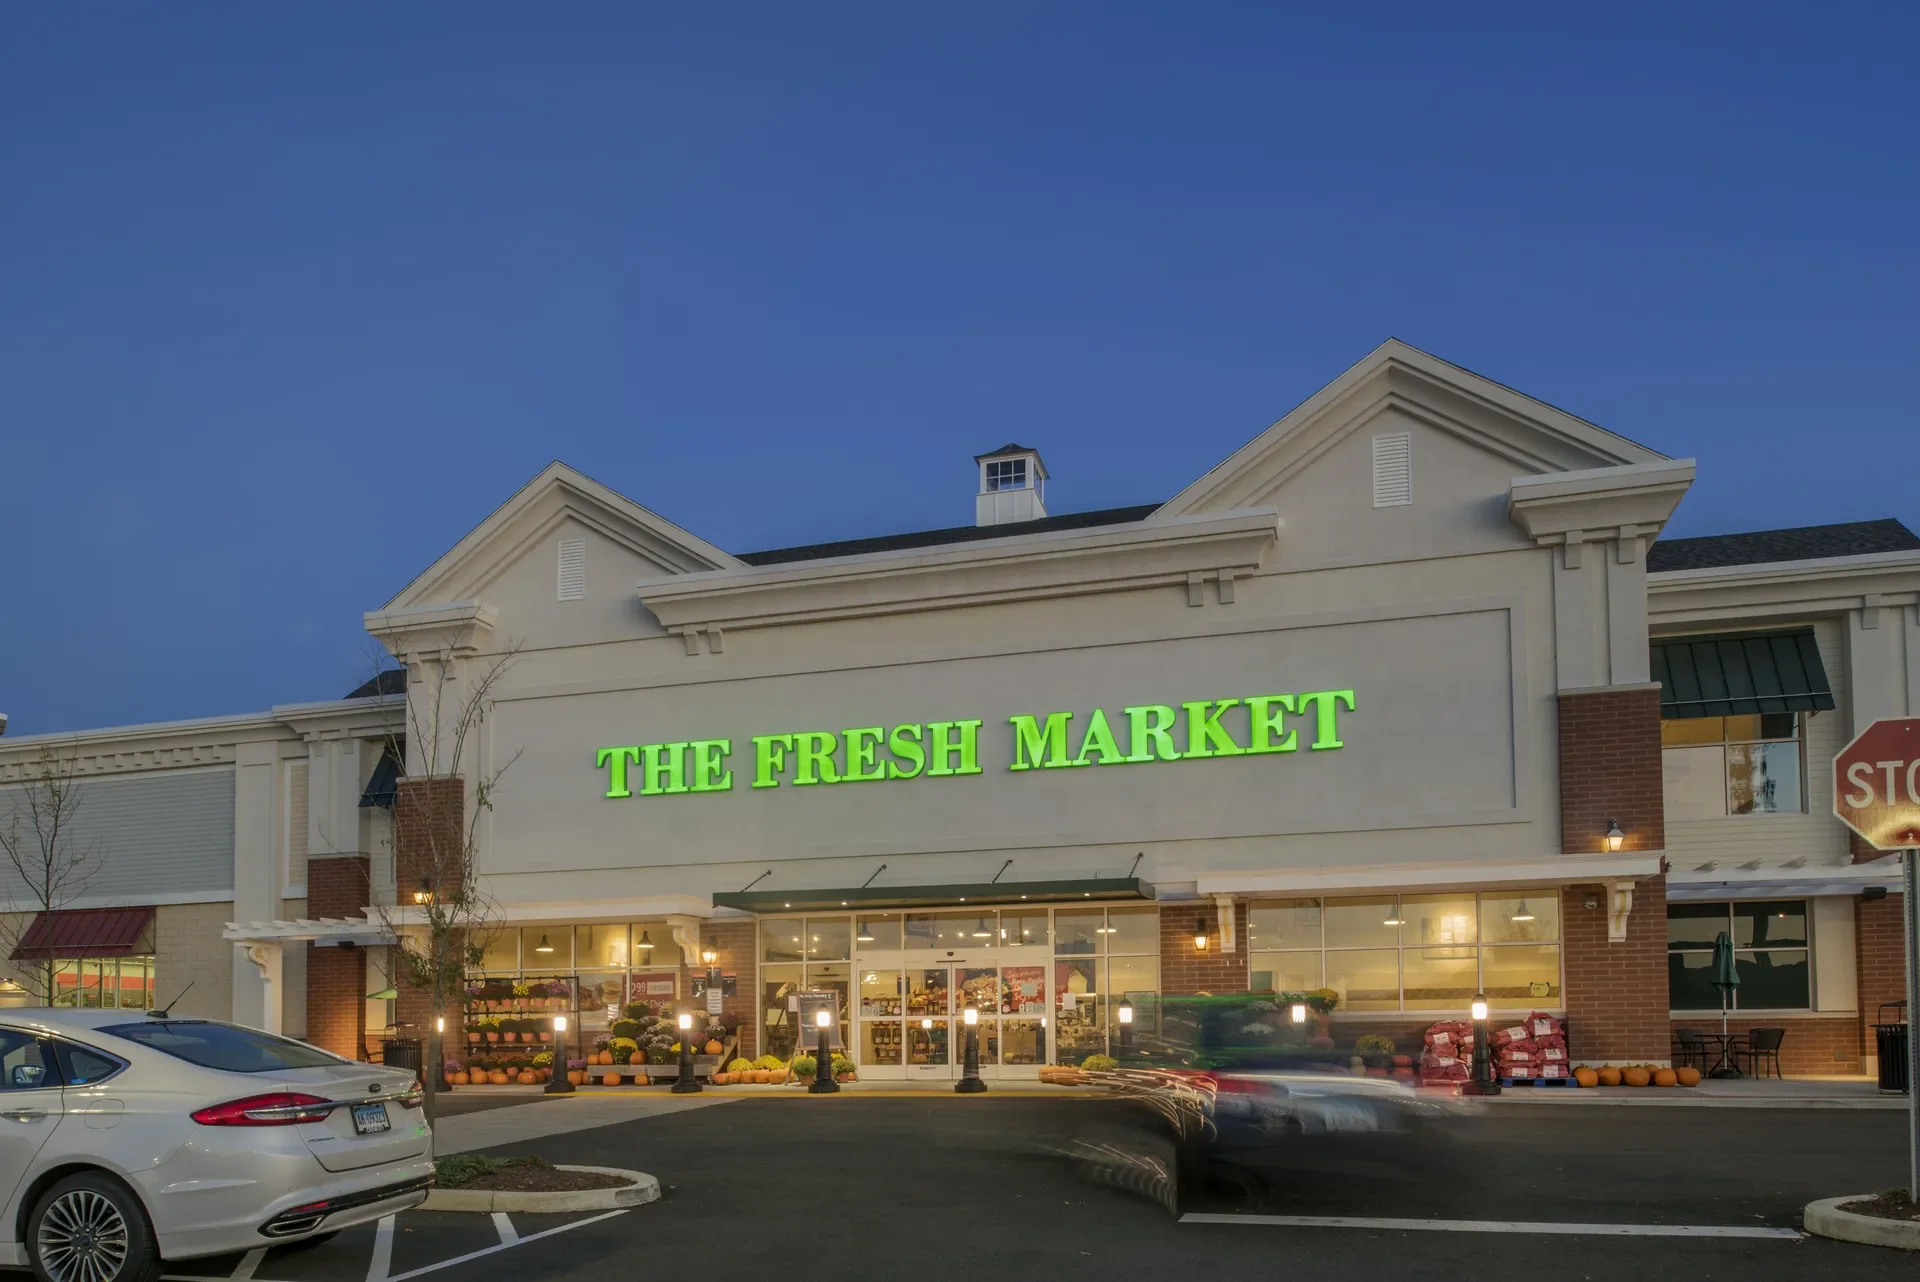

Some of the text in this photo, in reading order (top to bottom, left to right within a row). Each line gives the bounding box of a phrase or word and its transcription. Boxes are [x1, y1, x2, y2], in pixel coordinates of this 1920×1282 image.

[596, 689, 1356, 799] THE FRESH MARKET
